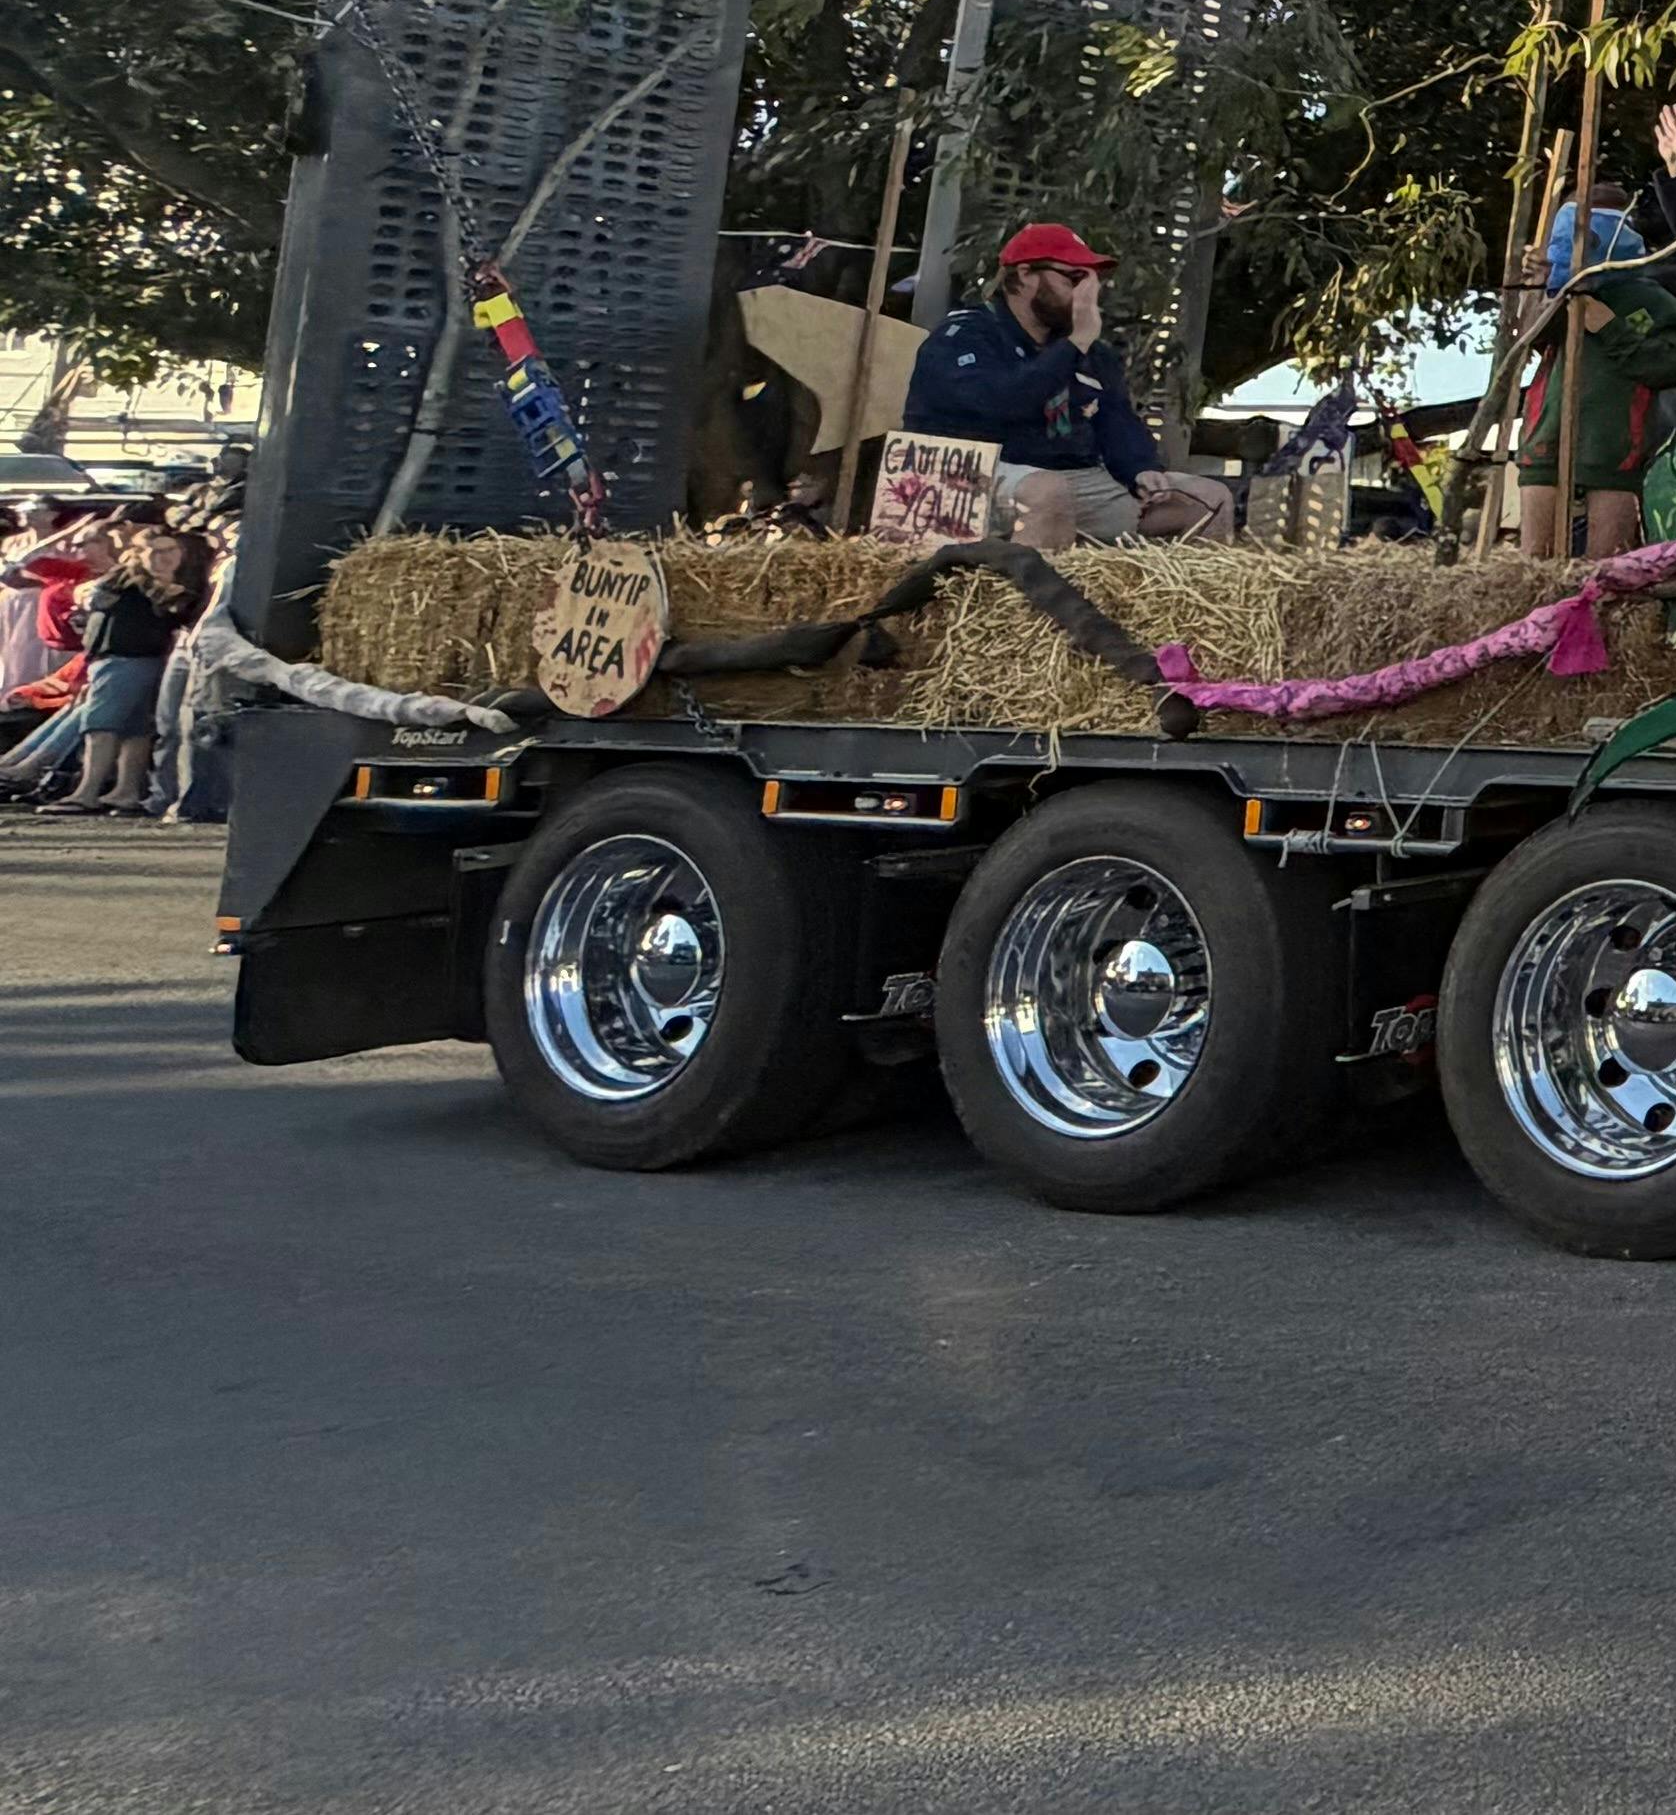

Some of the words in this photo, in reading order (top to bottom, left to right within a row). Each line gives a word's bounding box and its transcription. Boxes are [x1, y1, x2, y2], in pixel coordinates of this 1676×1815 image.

[884, 437, 982, 484] CAUTION
[569, 559, 650, 606] BUNYIP
[584, 605, 610, 628] IN
[550, 627, 625, 680] AREA
[390, 726, 468, 749] TopStart
